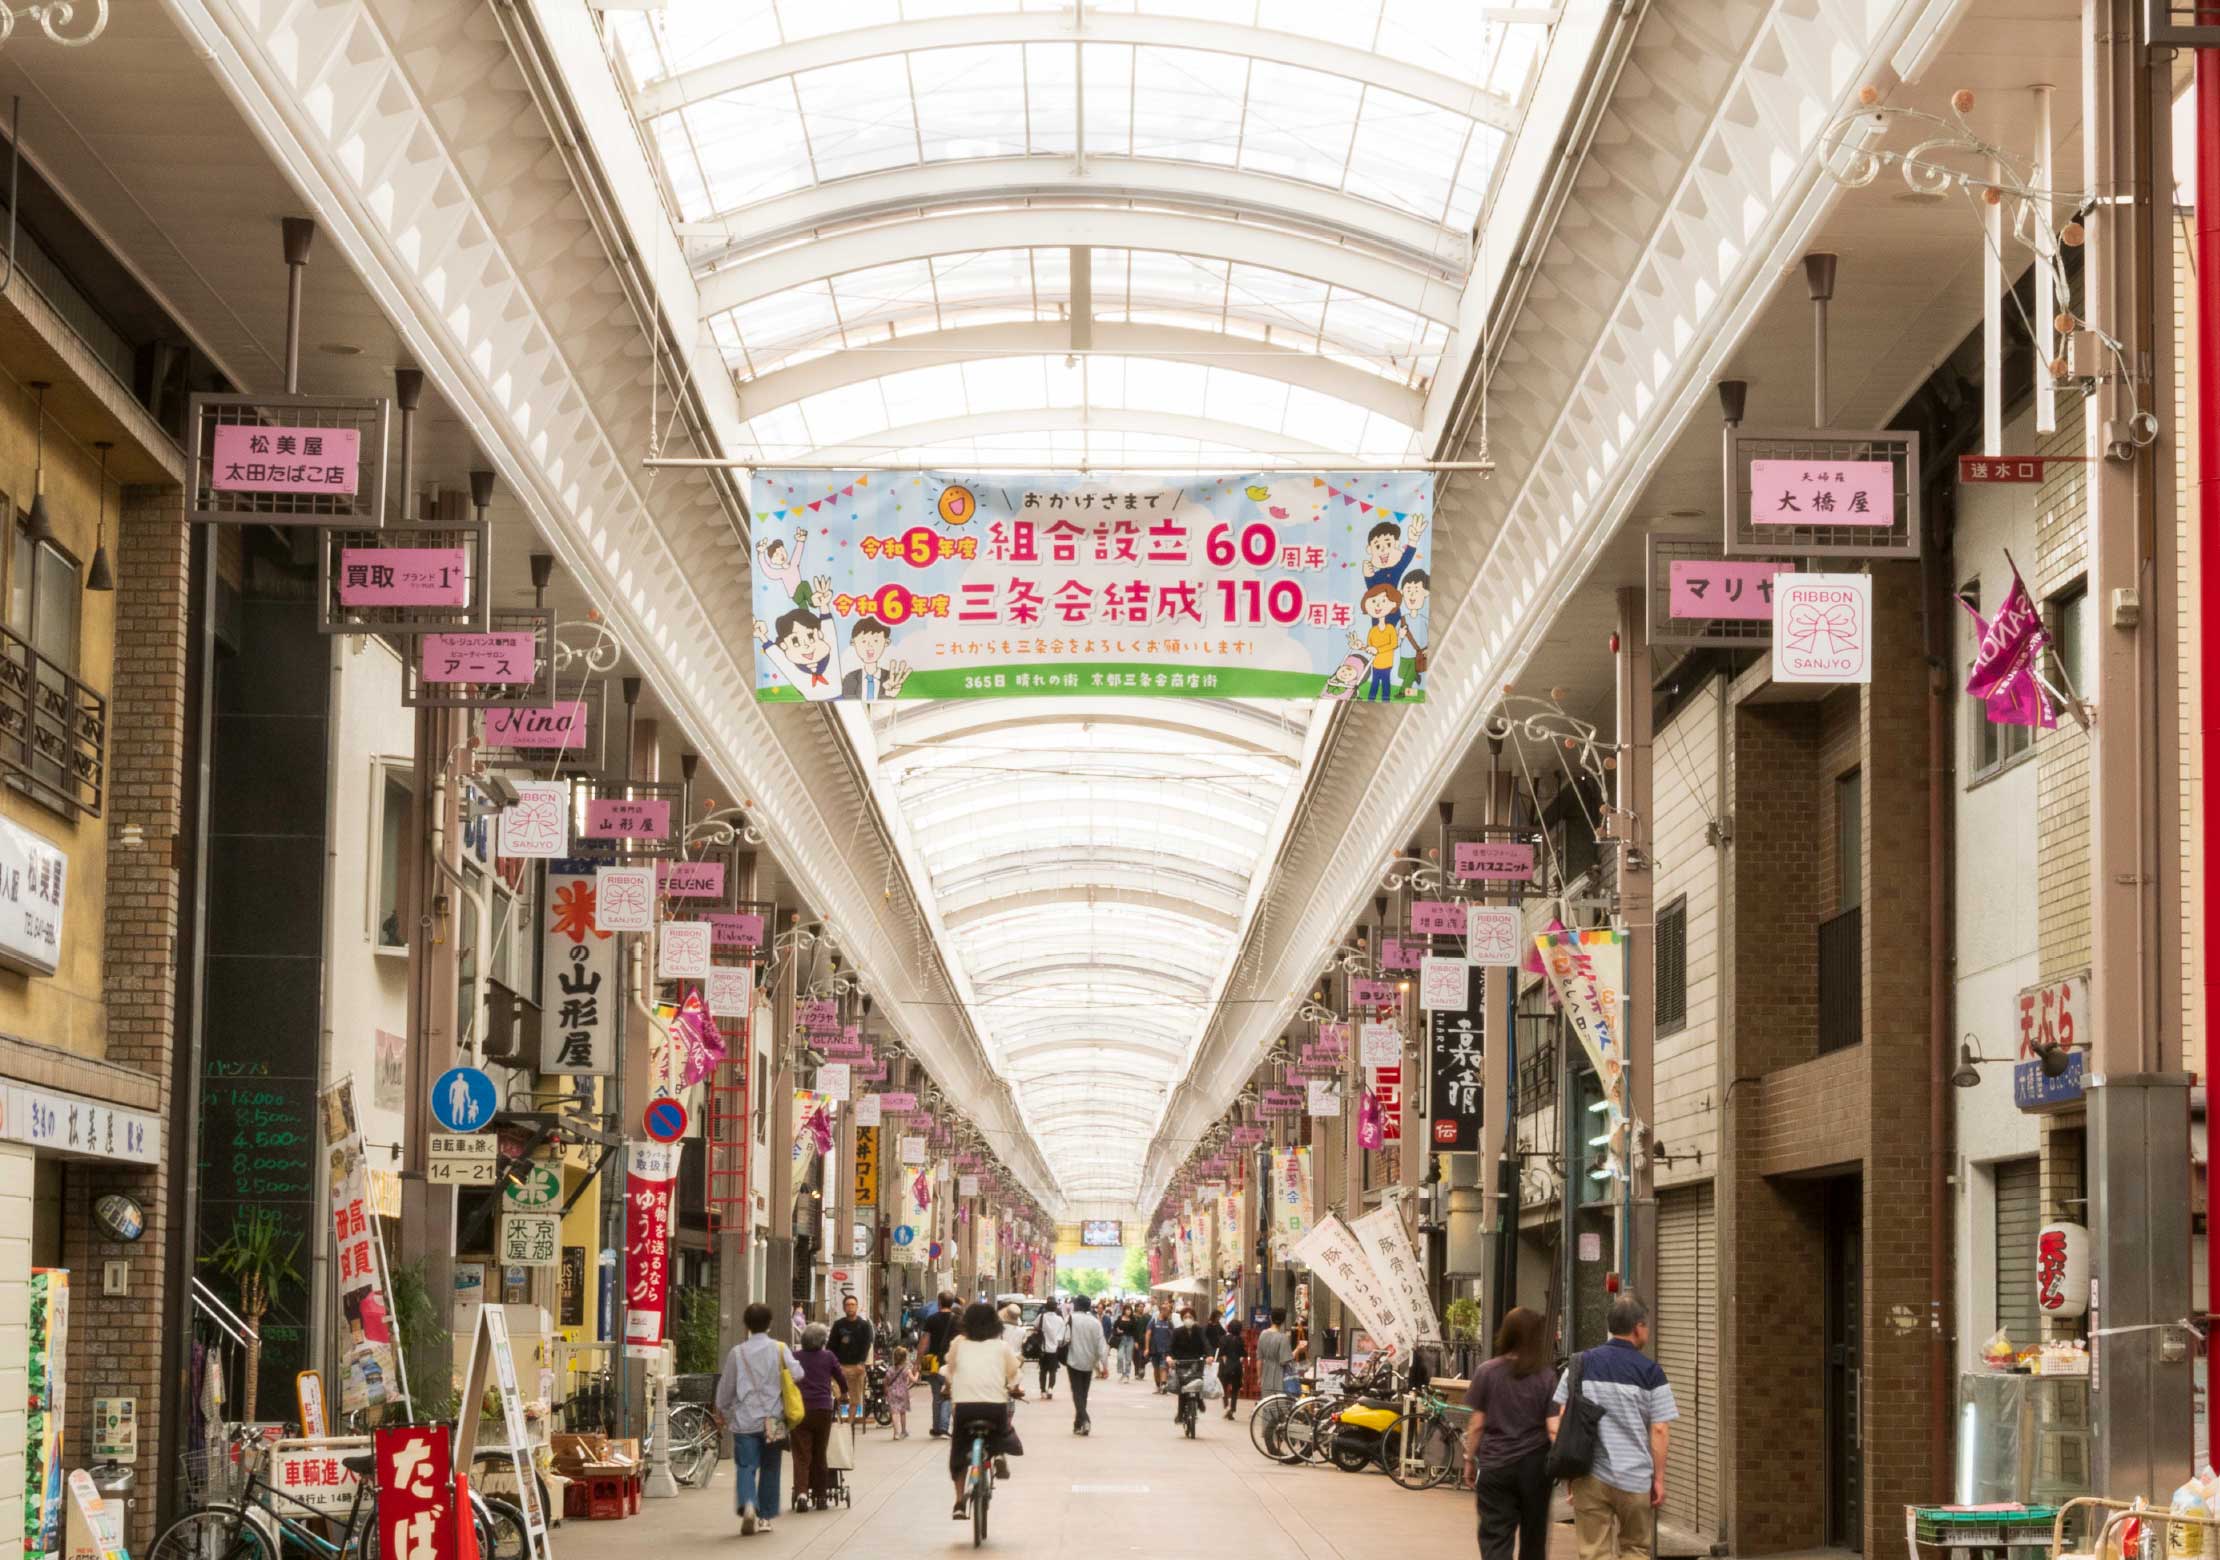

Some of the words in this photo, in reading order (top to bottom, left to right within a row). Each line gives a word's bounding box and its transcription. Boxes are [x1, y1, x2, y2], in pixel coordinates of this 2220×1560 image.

[250, 435, 322, 456] 松美屋
[225, 463, 345, 485] 太田たばこ店
[1801, 472, 1845, 483] 天婦羅
[1971, 463, 2033, 479] 送水口
[1024, 491, 1162, 511] おかげさまで
[1777, 490, 1870, 513] 大橋屋
[860, 531, 977, 562] 令和5年度
[347, 565, 395, 588] 買取
[402, 573, 435, 582] ブランド
[833, 588, 949, 622] 令和6年度
[1792, 591, 1853, 604] RIBBON
[444, 659, 513, 676] アース
[1794, 658, 1851, 670] SANJYO
[964, 675, 1006, 689] 365日
[1016, 674, 1078, 690] 晴れの街
[1090, 674, 1217, 690] 京都三条会商店街
[495, 707, 575, 734] Nina
[599, 817, 655, 833] 山形屋
[607, 877, 645, 885] RIBBON
[1477, 914, 1512, 923] RIBBON
[669, 929, 703, 939] RIBBON
[550, 880, 616, 1067] 米の山形屋
[1430, 965, 1461, 974] RIBBON
[813, 1035, 855, 1045] GLANCE
[432, 1138, 495, 1153] 自転車を除く
[632, 1188, 656, 1302] ゆうパック
[648, 1191, 668, 1302] 荷物を送るなら
[285, 1459, 372, 1487] 車輛進入
